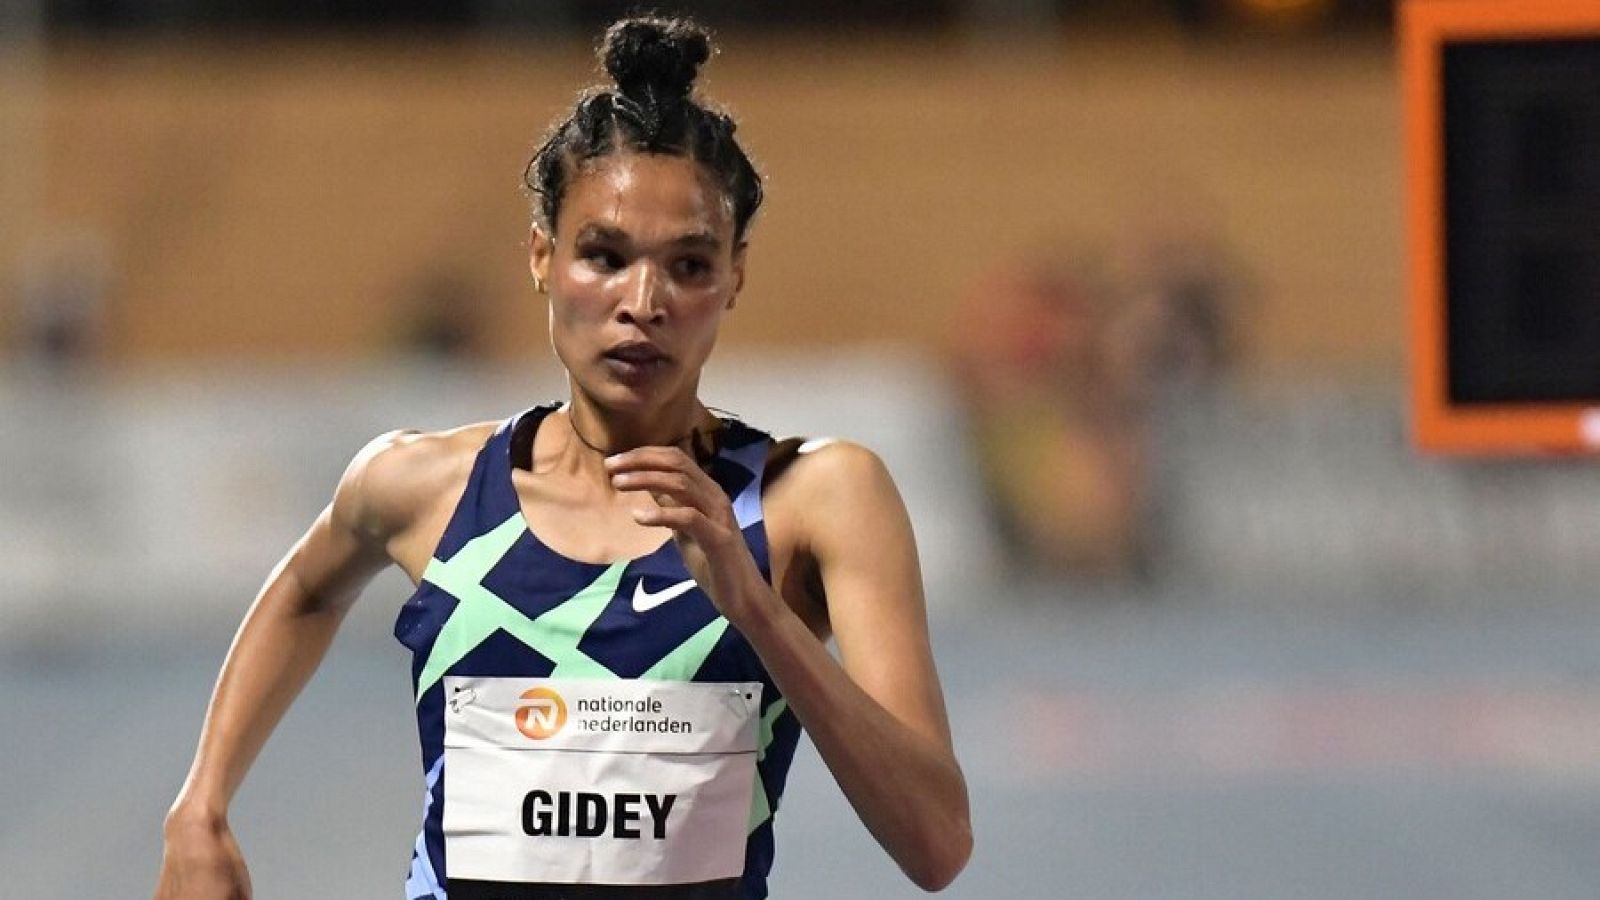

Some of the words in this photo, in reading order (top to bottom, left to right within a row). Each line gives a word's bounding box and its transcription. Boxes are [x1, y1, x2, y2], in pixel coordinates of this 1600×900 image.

[577, 697, 663, 713] nationale
[577, 716, 692, 734] nederlanden
[521, 789, 678, 839] GIDEY
